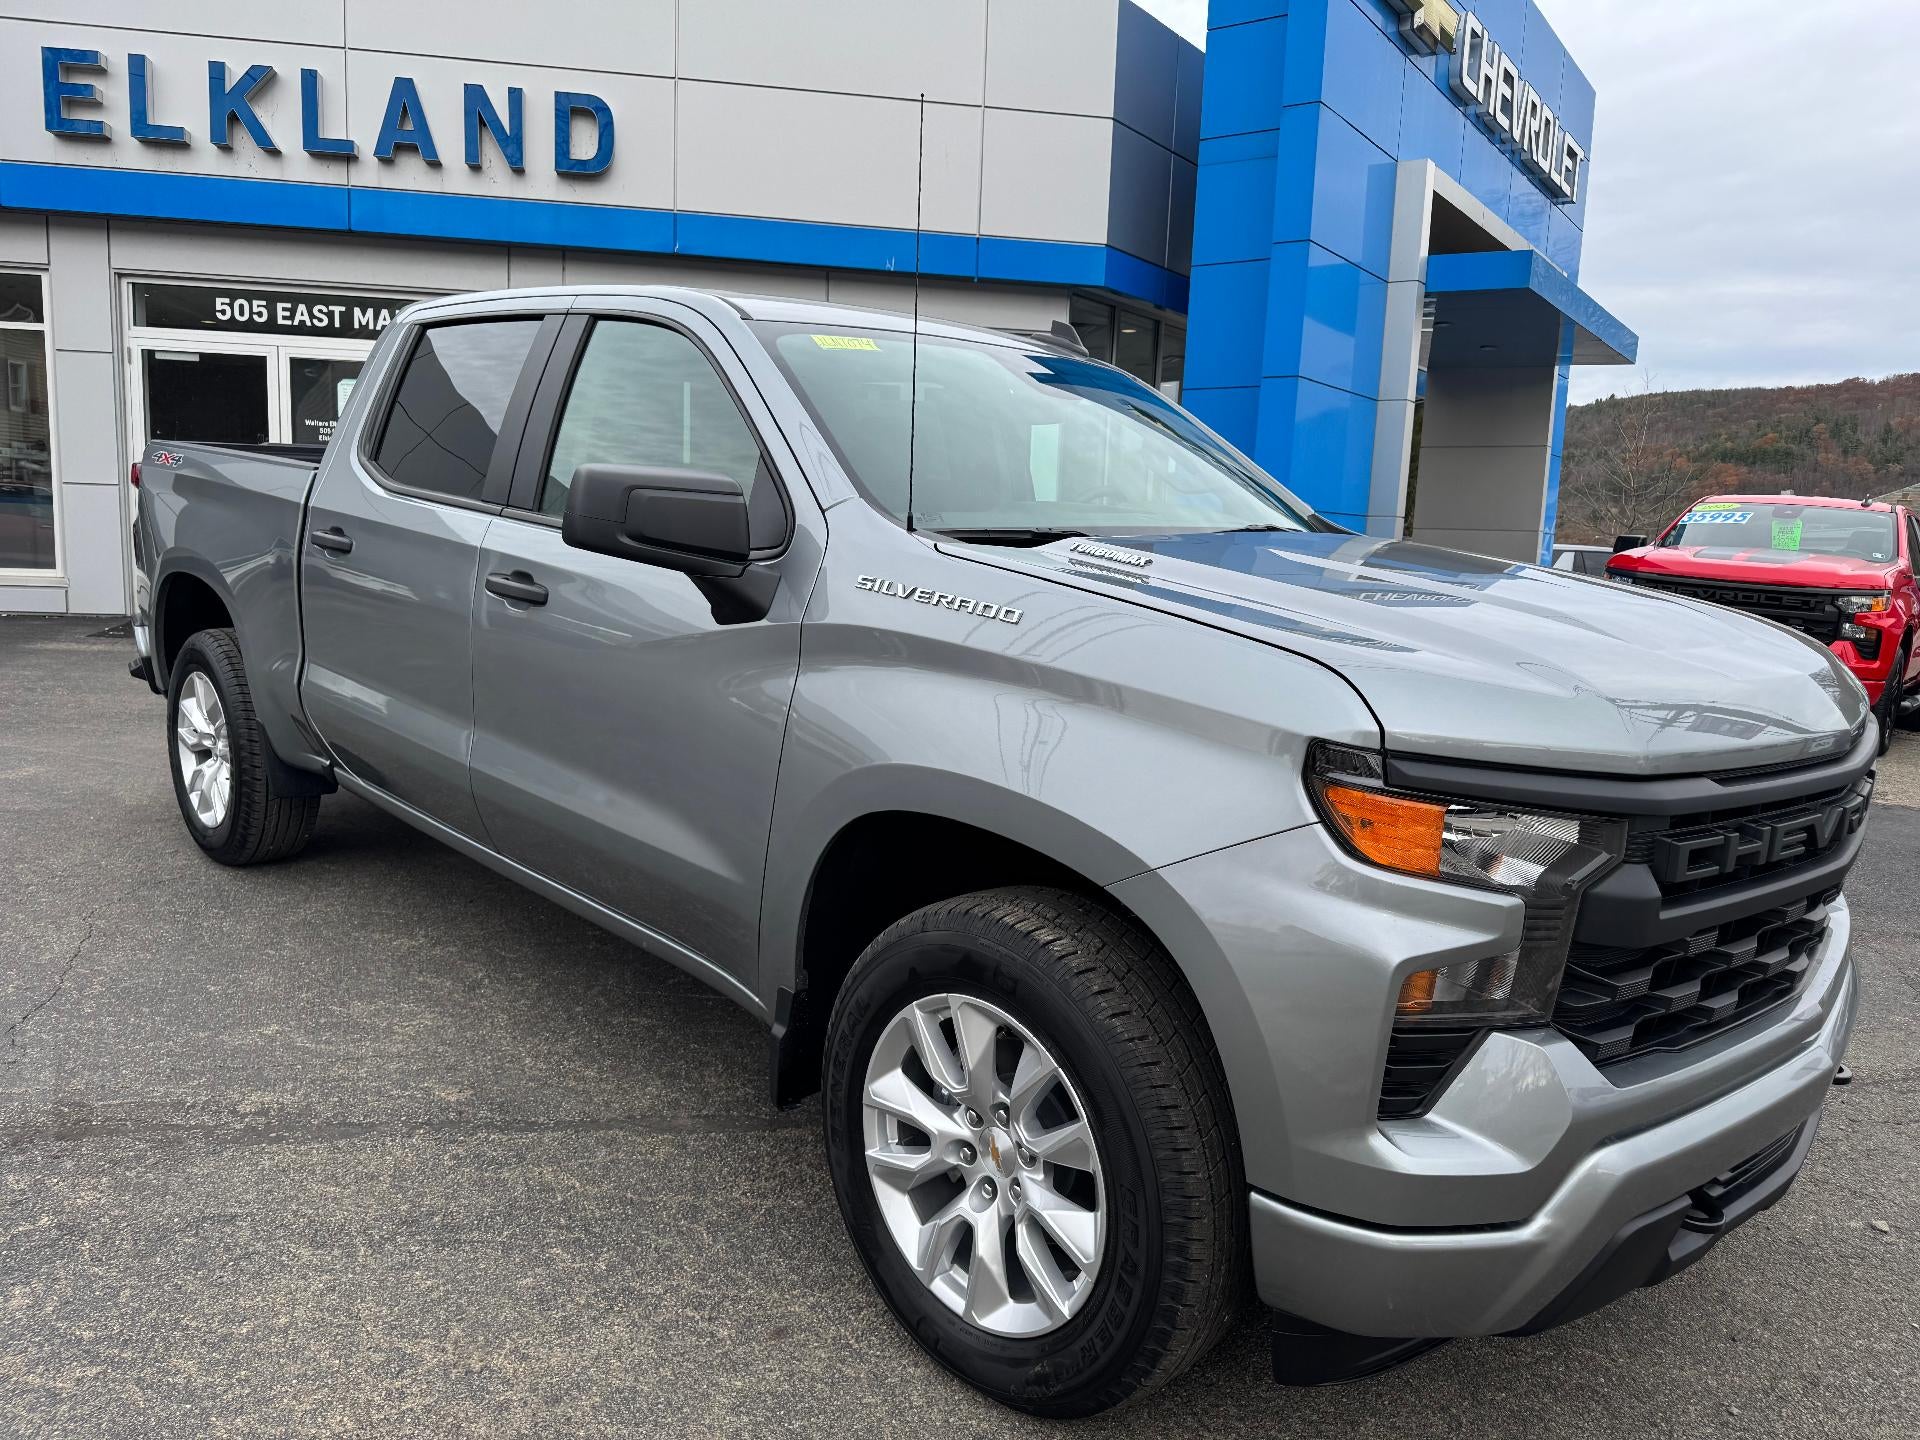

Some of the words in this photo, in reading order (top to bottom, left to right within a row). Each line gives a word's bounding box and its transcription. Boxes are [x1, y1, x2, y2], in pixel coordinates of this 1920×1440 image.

[41, 46, 615, 175] ELKLAND
[1454, 11, 1585, 204] CHEVROLET
[215, 297, 268, 323] 505
[276, 302, 346, 328] EAST
[353, 306, 400, 330] MA
[305, 419, 329, 427] Walters
[1680, 512, 1752, 524] 35995
[1069, 542, 1153, 568] TURBOMAX
[855, 574, 1024, 625] SILVERADO
